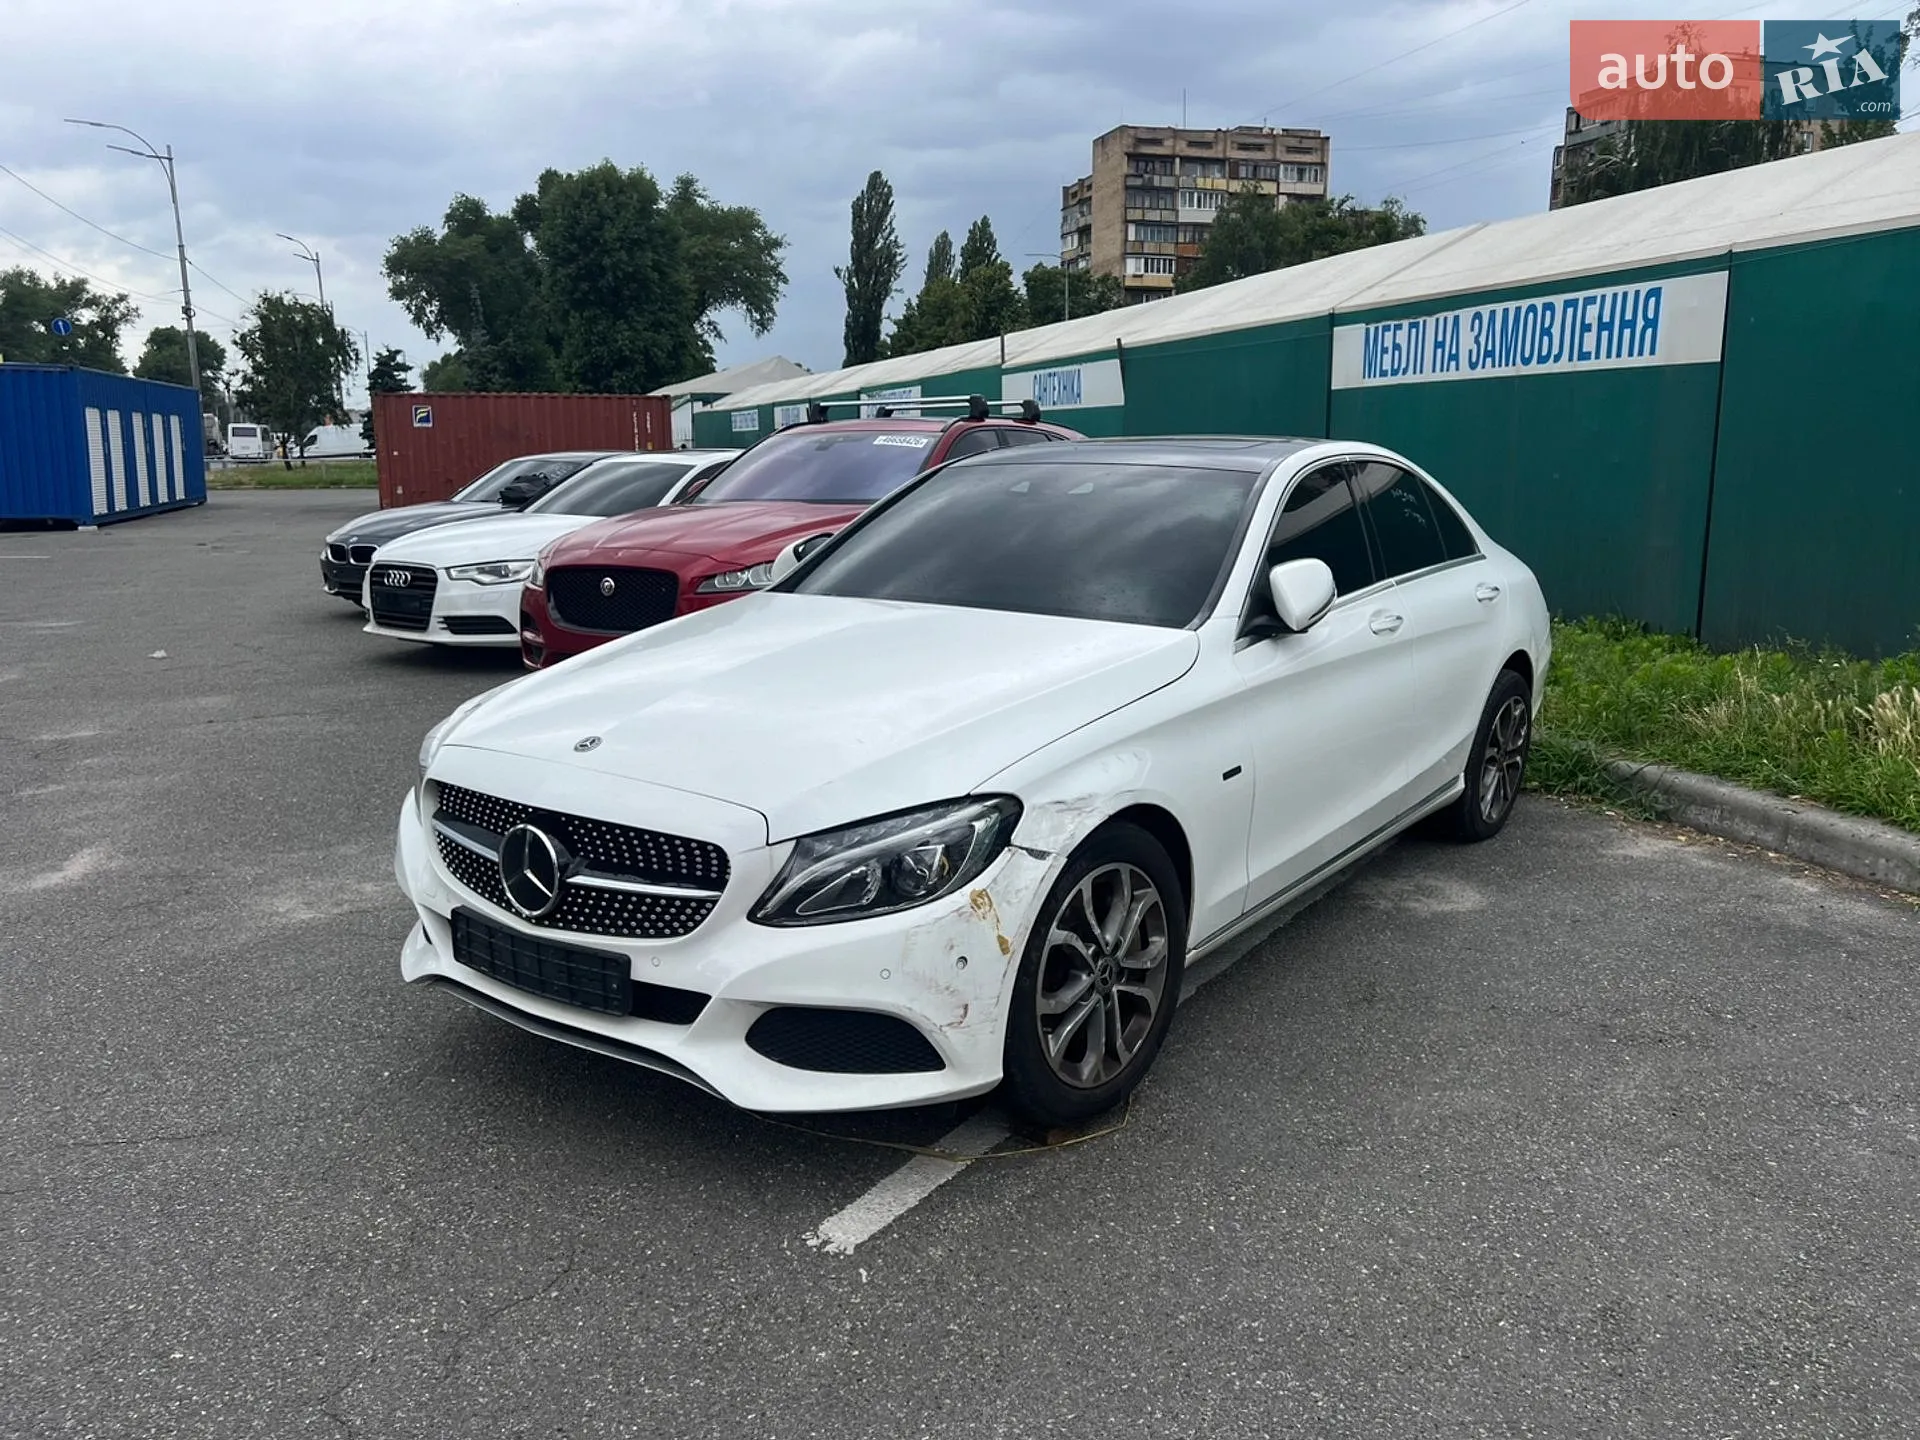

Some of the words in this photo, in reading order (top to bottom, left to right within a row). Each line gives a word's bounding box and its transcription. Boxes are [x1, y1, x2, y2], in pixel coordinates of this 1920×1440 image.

[1363, 322, 1426, 379] МЕБЛІ
[1432, 315, 1460, 373] НА
[1468, 287, 1662, 370] ЗАМОВЛЕННЯ
